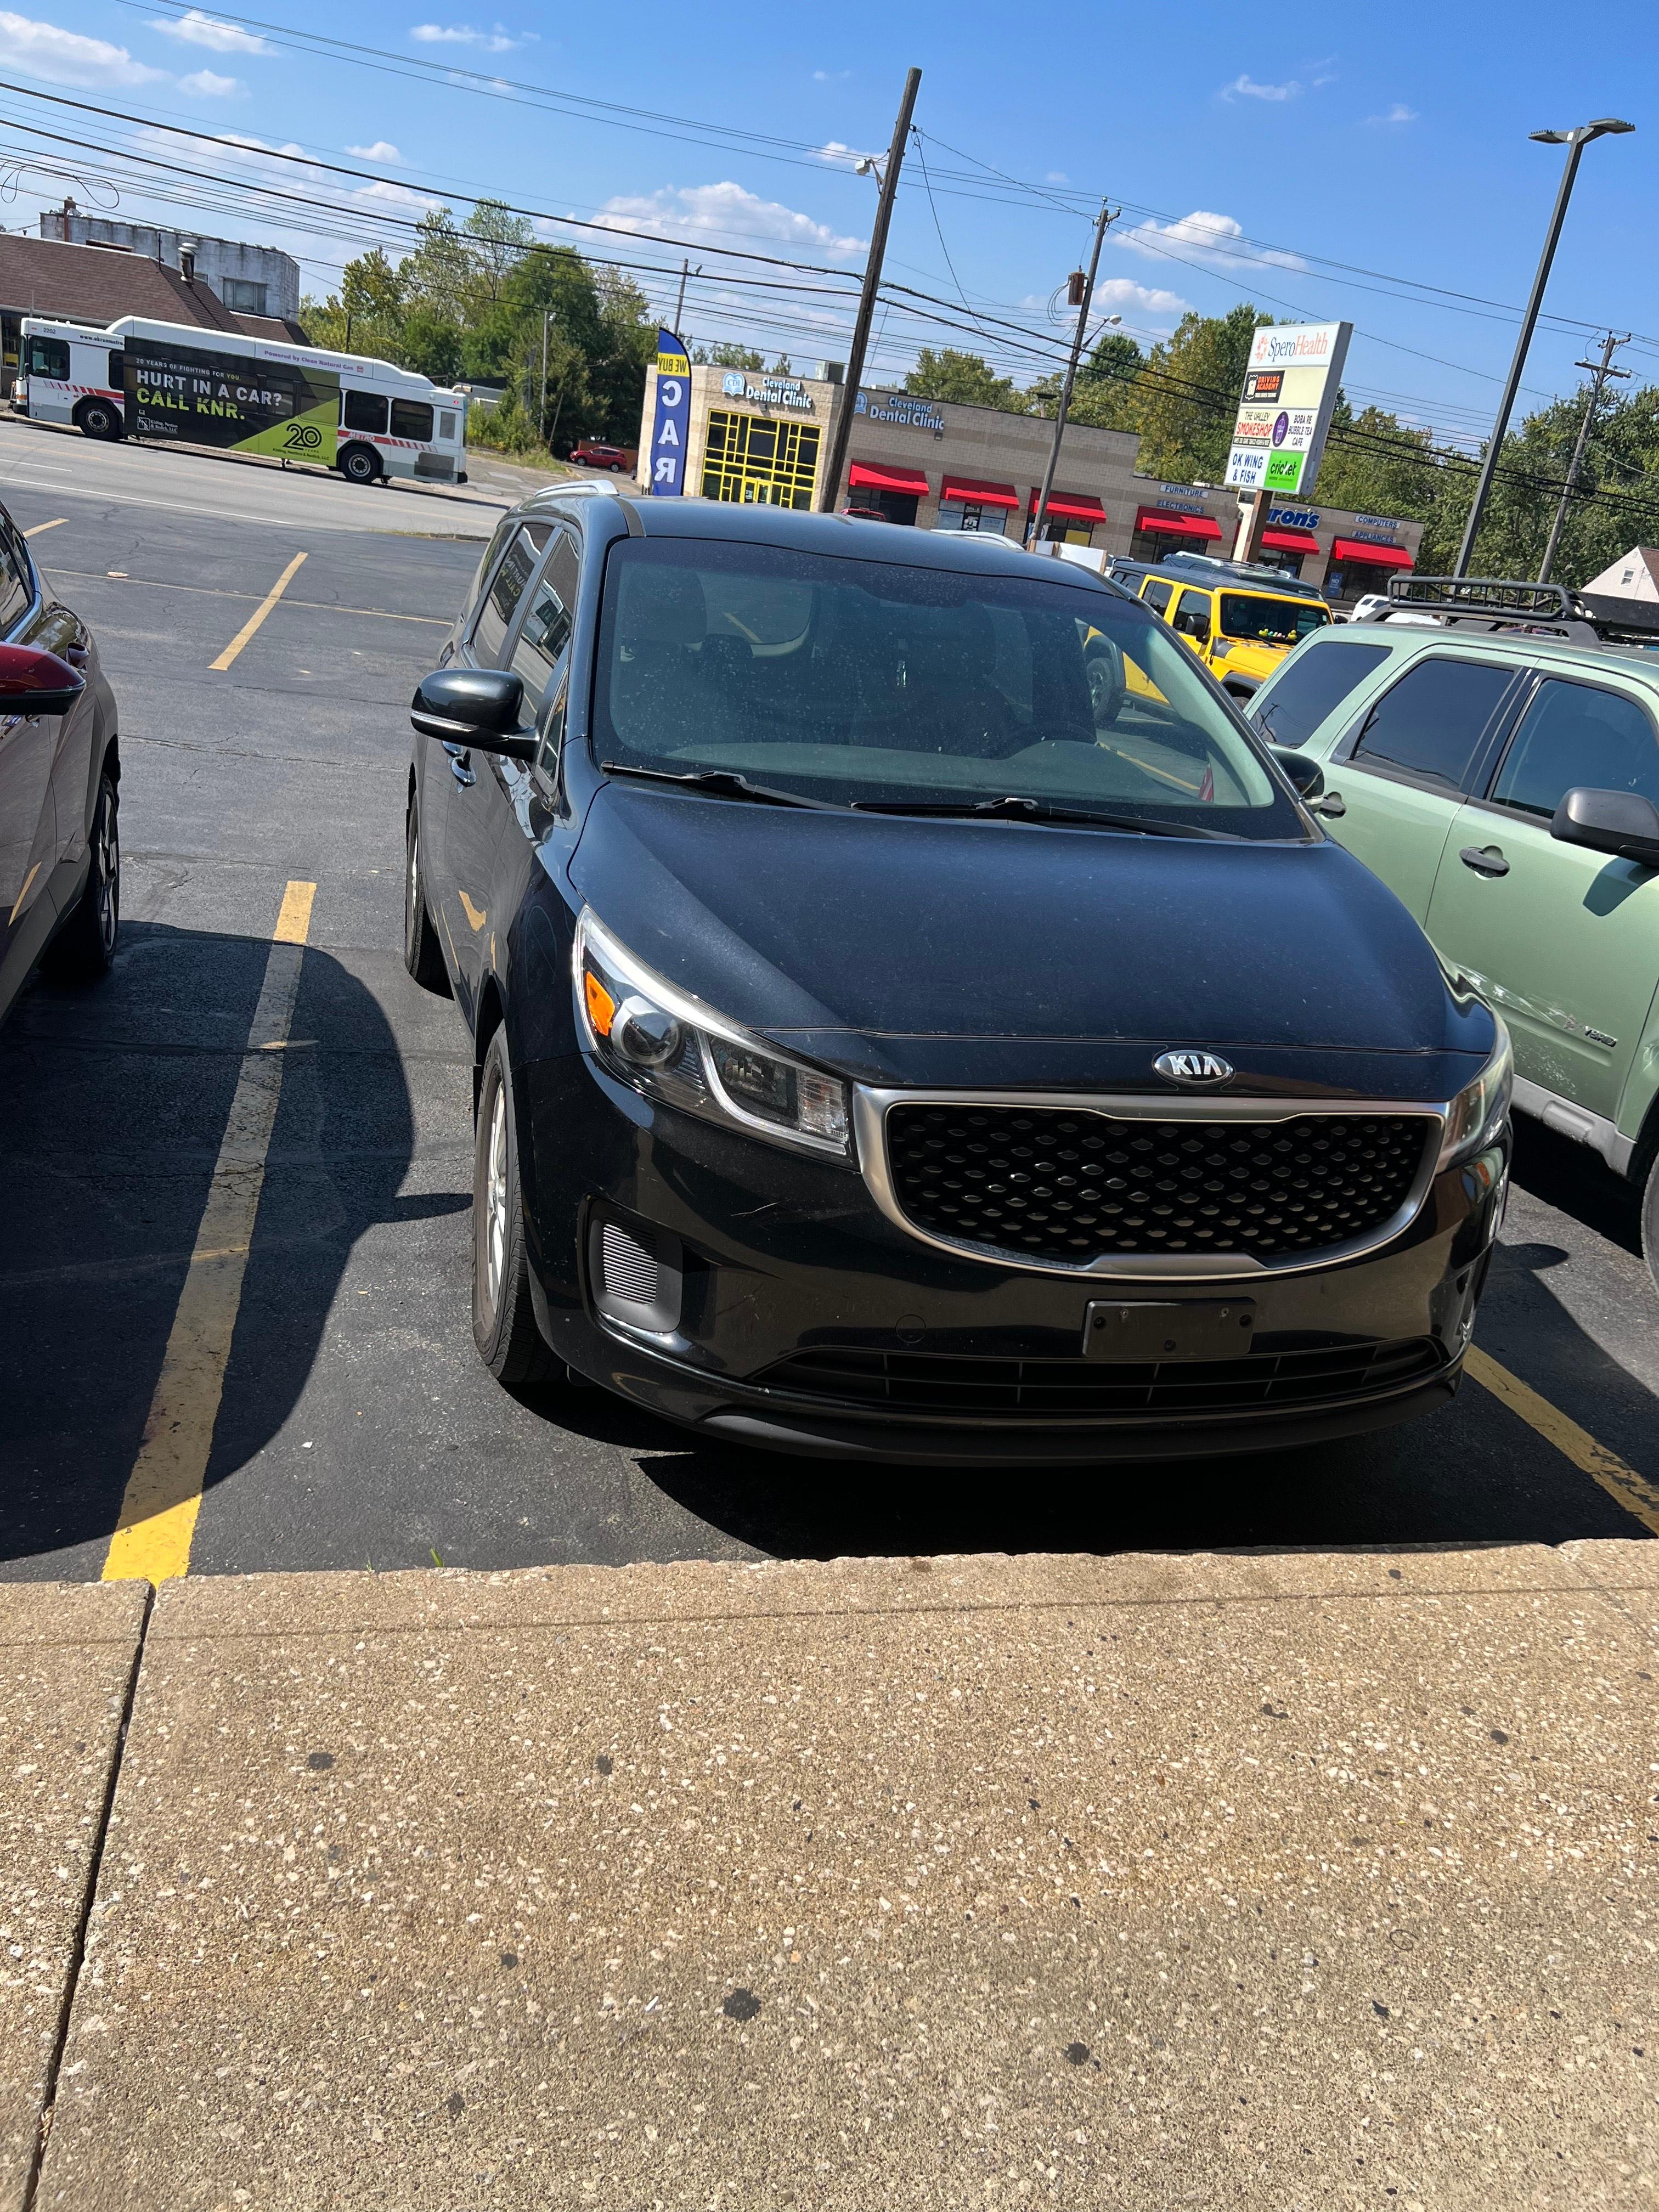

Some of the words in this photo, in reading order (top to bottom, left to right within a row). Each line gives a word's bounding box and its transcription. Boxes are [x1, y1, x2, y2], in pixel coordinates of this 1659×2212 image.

[1268, 332, 1328, 362] SperoHealth
[146, 359, 167, 368] YEARS
[179, 365, 211, 376] FIGHTING
[264, 350, 291, 359] Powered
[319, 360, 342, 369] Natural
[762, 377, 802, 392] Cleveland
[1257, 375, 1280, 383] DRIVING
[137, 370, 187, 391] HURT
[193, 379, 212, 396] IN
[218, 383, 230, 399] A
[236, 386, 283, 407] CAR?
[137, 387, 190, 411] CALL
[196, 397, 246, 420] KNR.
[746, 385, 782, 404] Dental
[782, 390, 812, 409] Clinic
[889, 397, 933, 413] Cleveland
[869, 405, 912, 425] Dental
[912, 412, 945, 430] Clinic
[1245, 411, 1254, 421] THE
[1254, 412, 1271, 421] VALLEY
[1294, 414, 1306, 424] BOBA
[282, 423, 323, 450] 20
[348, 432, 375, 442] METRO
[1237, 421, 1273, 437] SMOKESHOP
[1288, 426, 1305, 436] BUBBLE
[1304, 427, 1313, 436] TEA
[1292, 437, 1304, 447] CAFE
[1232, 453, 1244, 466] OK
[1244, 454, 1264, 469] WING
[1270, 460, 1297, 476] cricket
[1233, 469, 1238, 482] &
[1239, 470, 1257, 484] FISH
[1165, 485, 1204, 498] FURNITURE
[1157, 500, 1205, 515] ELECTRONICS
[1358, 516, 1398, 529] COMPUTERS
[1354, 531, 1394, 544] APPLIANCES
[1167, 1055, 1222, 1075] KIA
